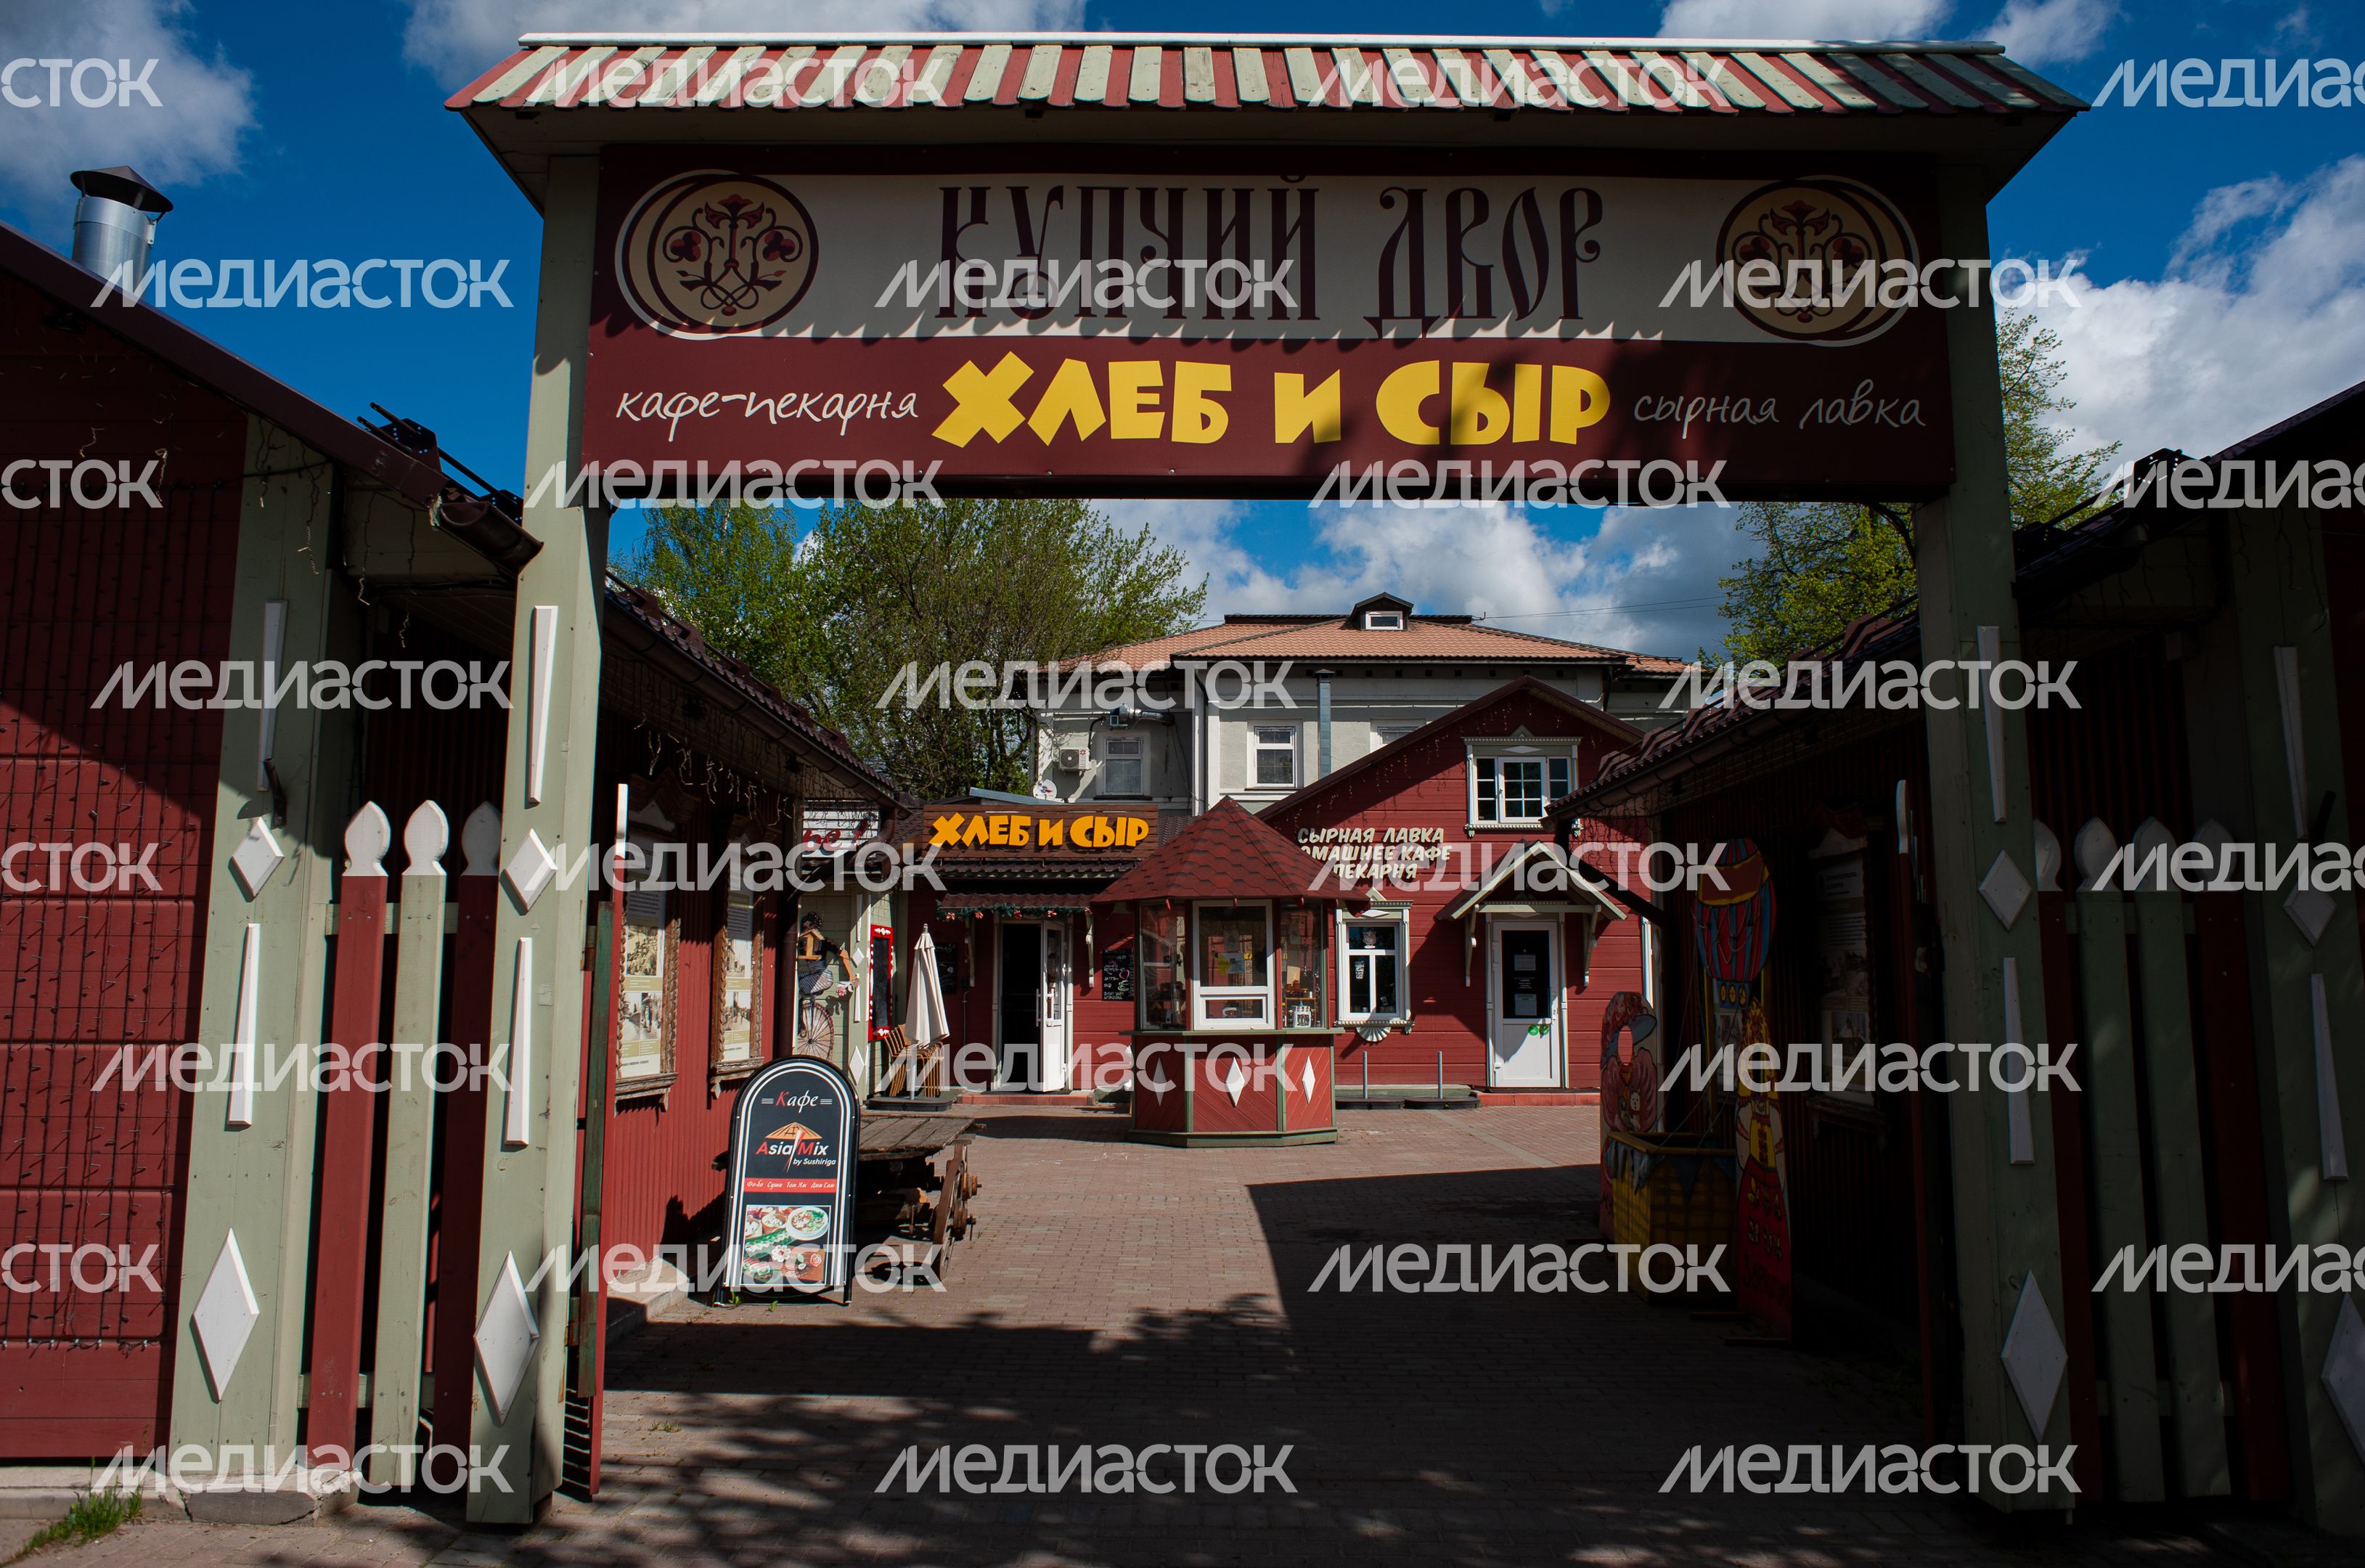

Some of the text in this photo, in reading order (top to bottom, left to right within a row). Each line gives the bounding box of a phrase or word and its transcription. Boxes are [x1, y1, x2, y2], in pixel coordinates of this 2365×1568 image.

[934, 173, 1603, 338] КУПЧИЙ ДВОР
[616, 387, 919, 442] кафе-пекарня
[931, 351, 1232, 448] ХЛЕБ
[1375, 359, 1611, 446] СЫР
[1633, 388, 1778, 440] сырная
[1799, 378, 1926, 430] лавка
[928, 812, 1031, 848] ХЛЕБ
[1070, 816, 1149, 848] СЫР
[1297, 827, 1445, 844] СЫРНАЯ ЛАВКА
[1299, 844, 1453, 862] ОМАШНЕЕ КАФЕ
[1333, 862, 1418, 880] ПЕКАРНЯ
[775, 1090, 819, 1114] Кафе
[803, 1157, 836, 1167] Sushiriga
[767, 1181, 783, 1191] Суши
